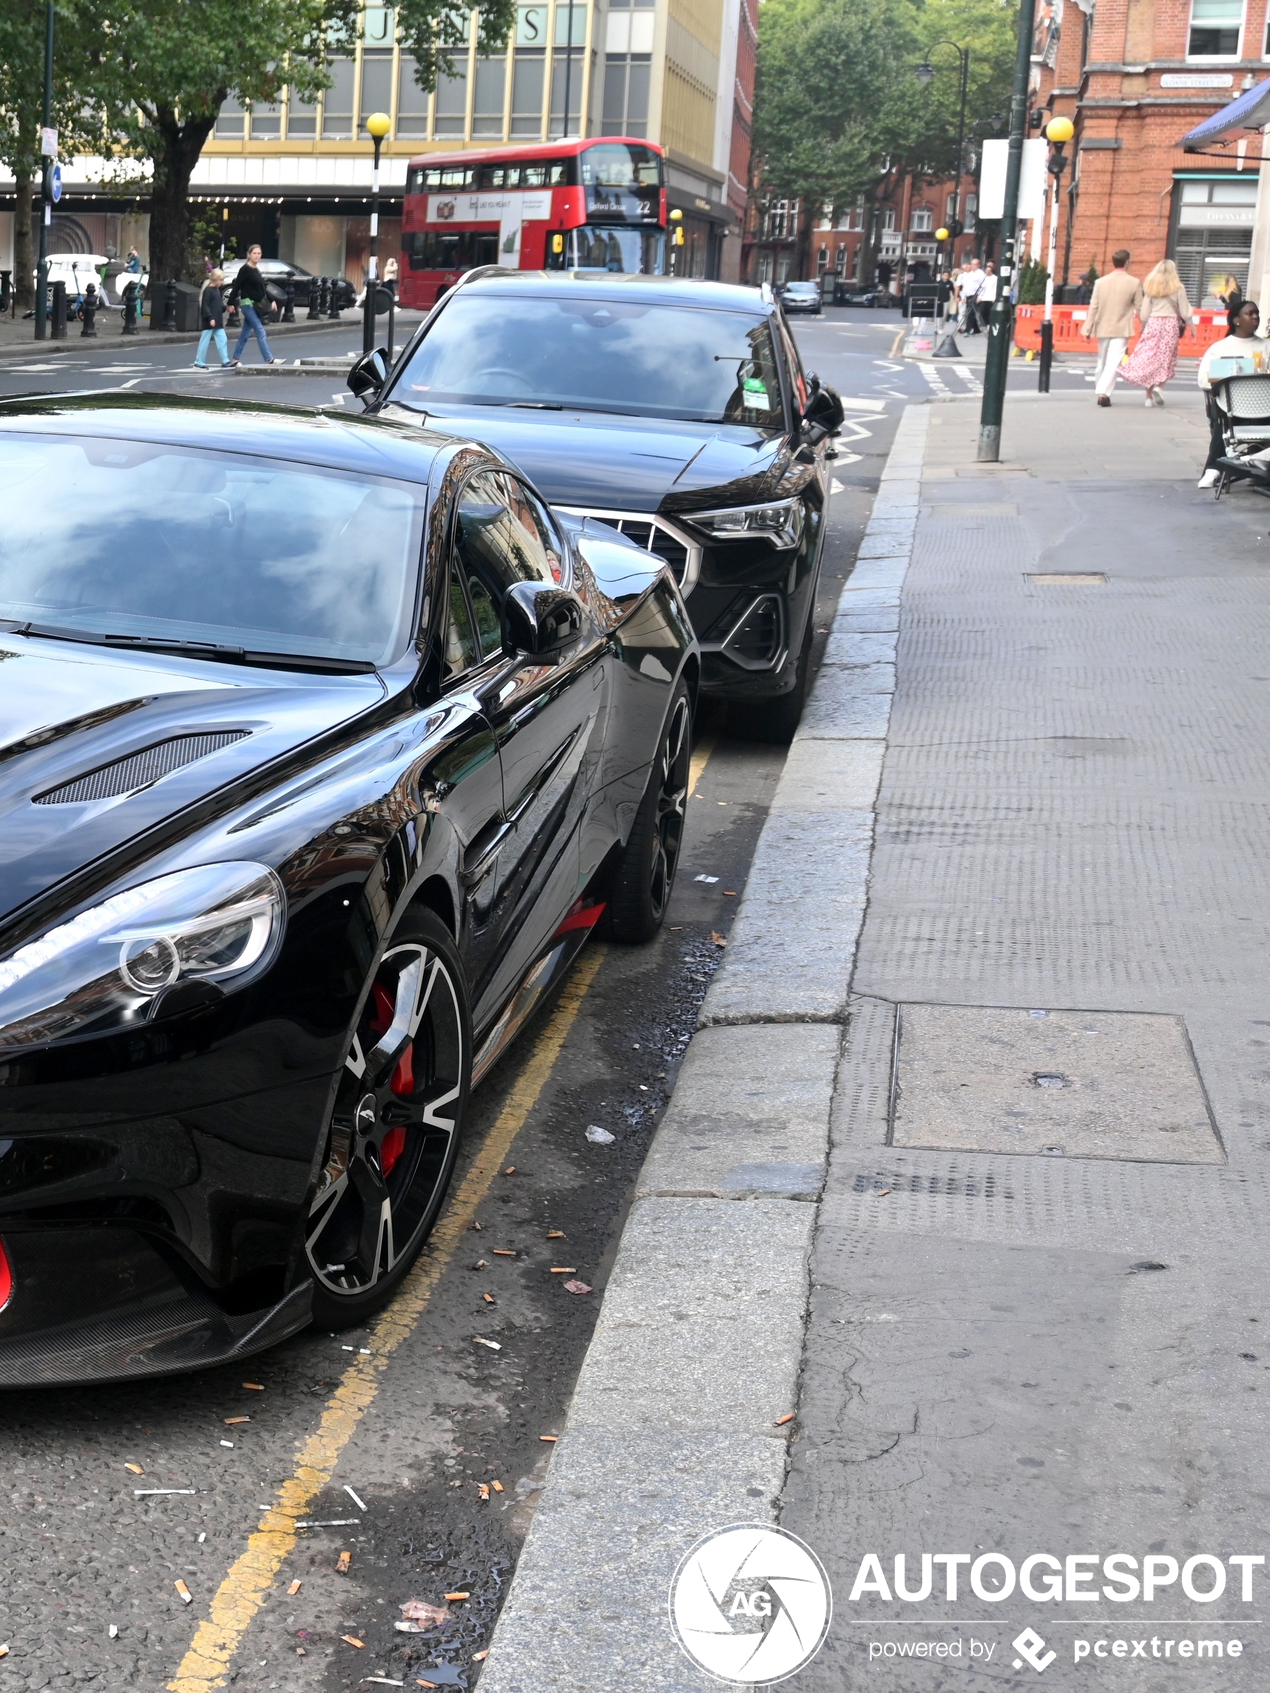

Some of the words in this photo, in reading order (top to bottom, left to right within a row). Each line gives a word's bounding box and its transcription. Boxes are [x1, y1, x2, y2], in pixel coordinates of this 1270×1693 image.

[589, 201, 609, 210] Oxford
[610, 202, 627, 211] Circus
[636, 201, 651, 214] 22
